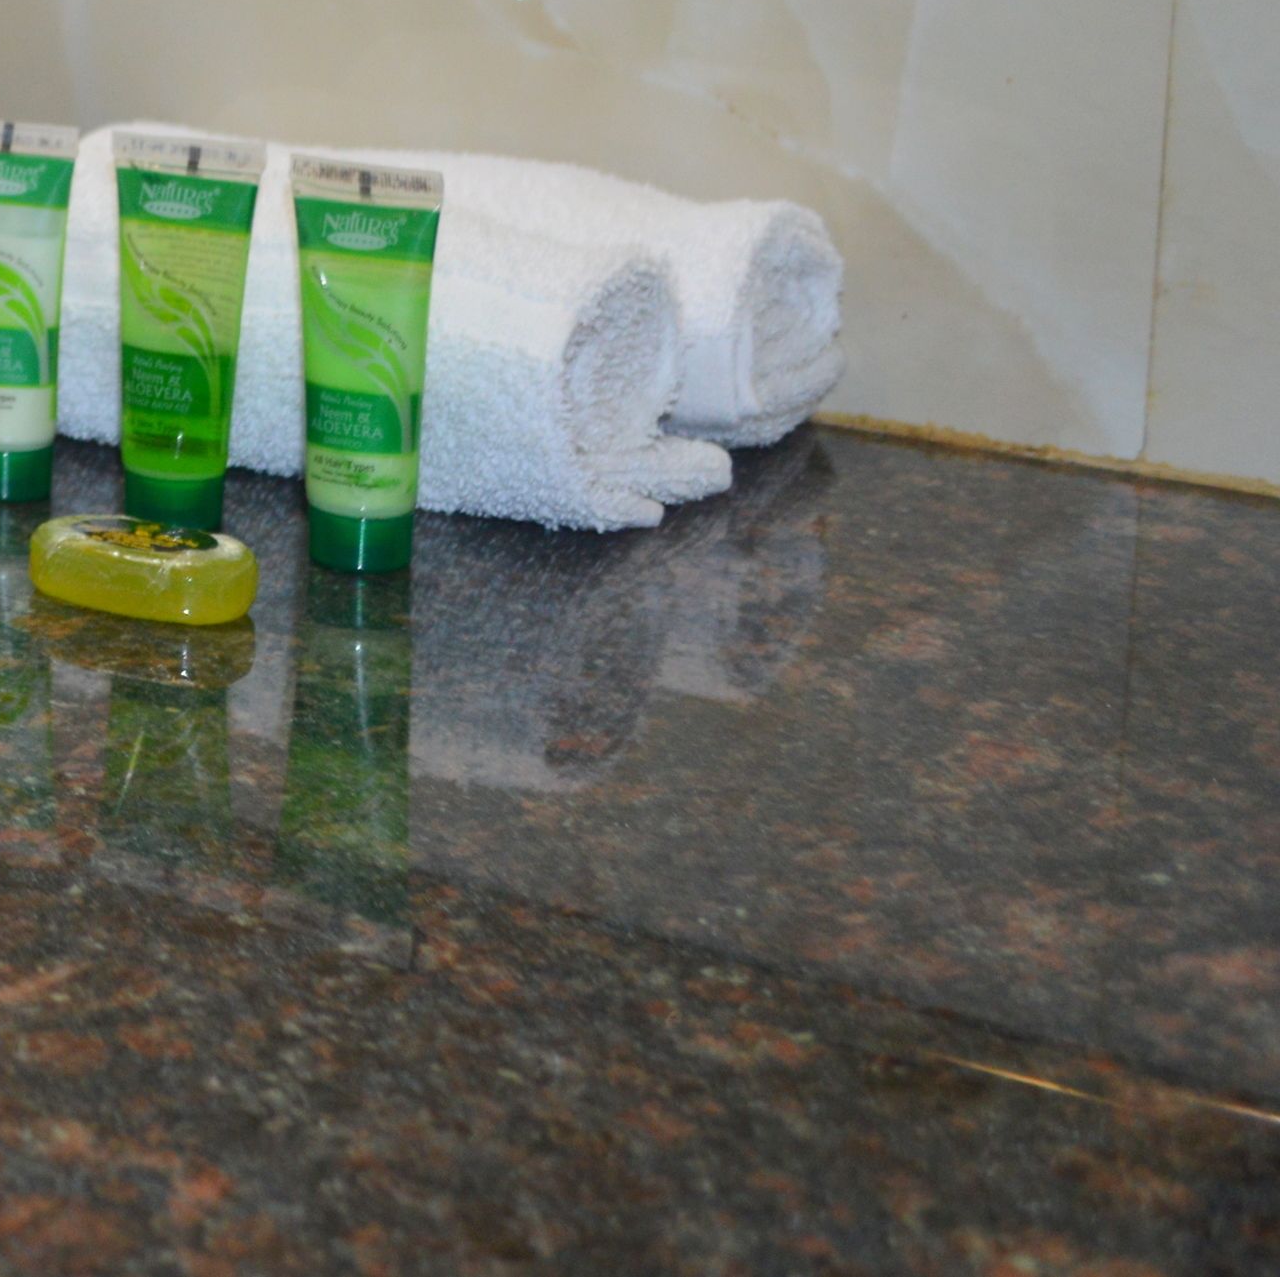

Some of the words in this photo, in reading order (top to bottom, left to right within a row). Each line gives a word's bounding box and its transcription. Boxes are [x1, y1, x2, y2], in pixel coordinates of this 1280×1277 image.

[320, 403, 352, 423] Neem
[357, 412, 371, 424] &
[311, 416, 385, 440] ALOEVERA
